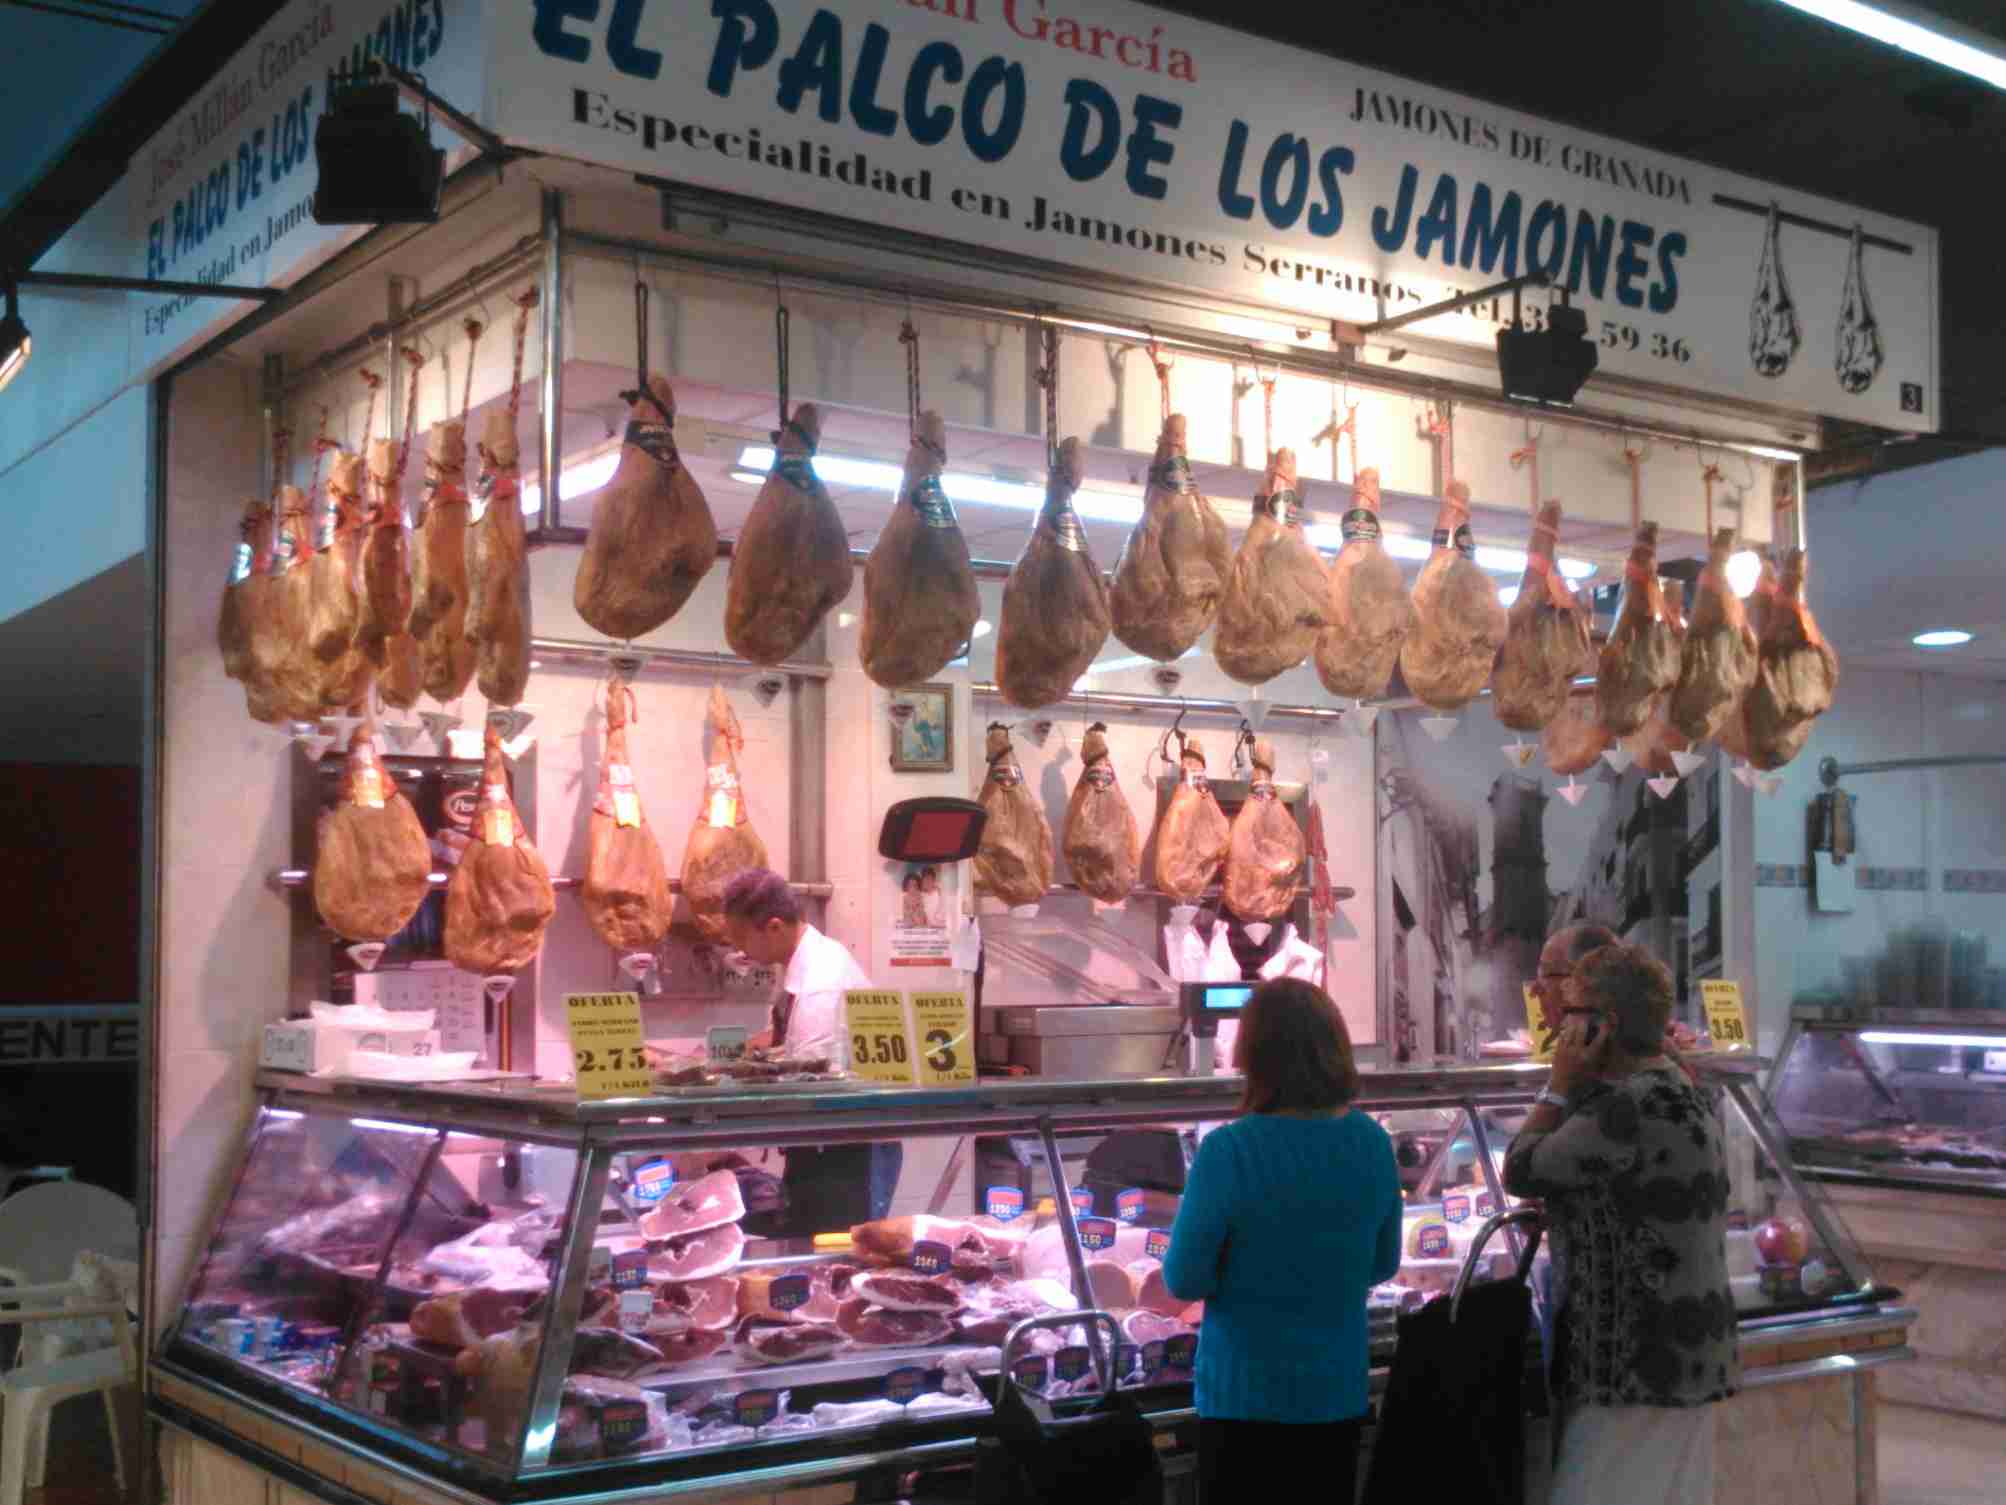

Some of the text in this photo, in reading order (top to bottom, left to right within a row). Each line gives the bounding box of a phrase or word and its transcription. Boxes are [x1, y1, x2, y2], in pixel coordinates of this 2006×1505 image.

[147, 215, 166, 283] EL
[172, 160, 230, 264] PALCO
[237, 129, 265, 212] DE
[268, 85, 313, 183] LOS
[532, 0, 1688, 314] EL PALCO DE LOS JAMONES
[570, 84, 933, 201] Especialidad
[950, 188, 1010, 219] en
[1024, 197, 1227, 265] Jamones
[1243, 242, 1422, 304] Serranos
[1600, 321, 1640, 352] 59
[1651, 332, 1692, 364] 36
[1349, 87, 1693, 206] JAMONES DE GRANADA
[852, 1033, 907, 1064] 3.50
[925, 1028, 957, 1073] 3
